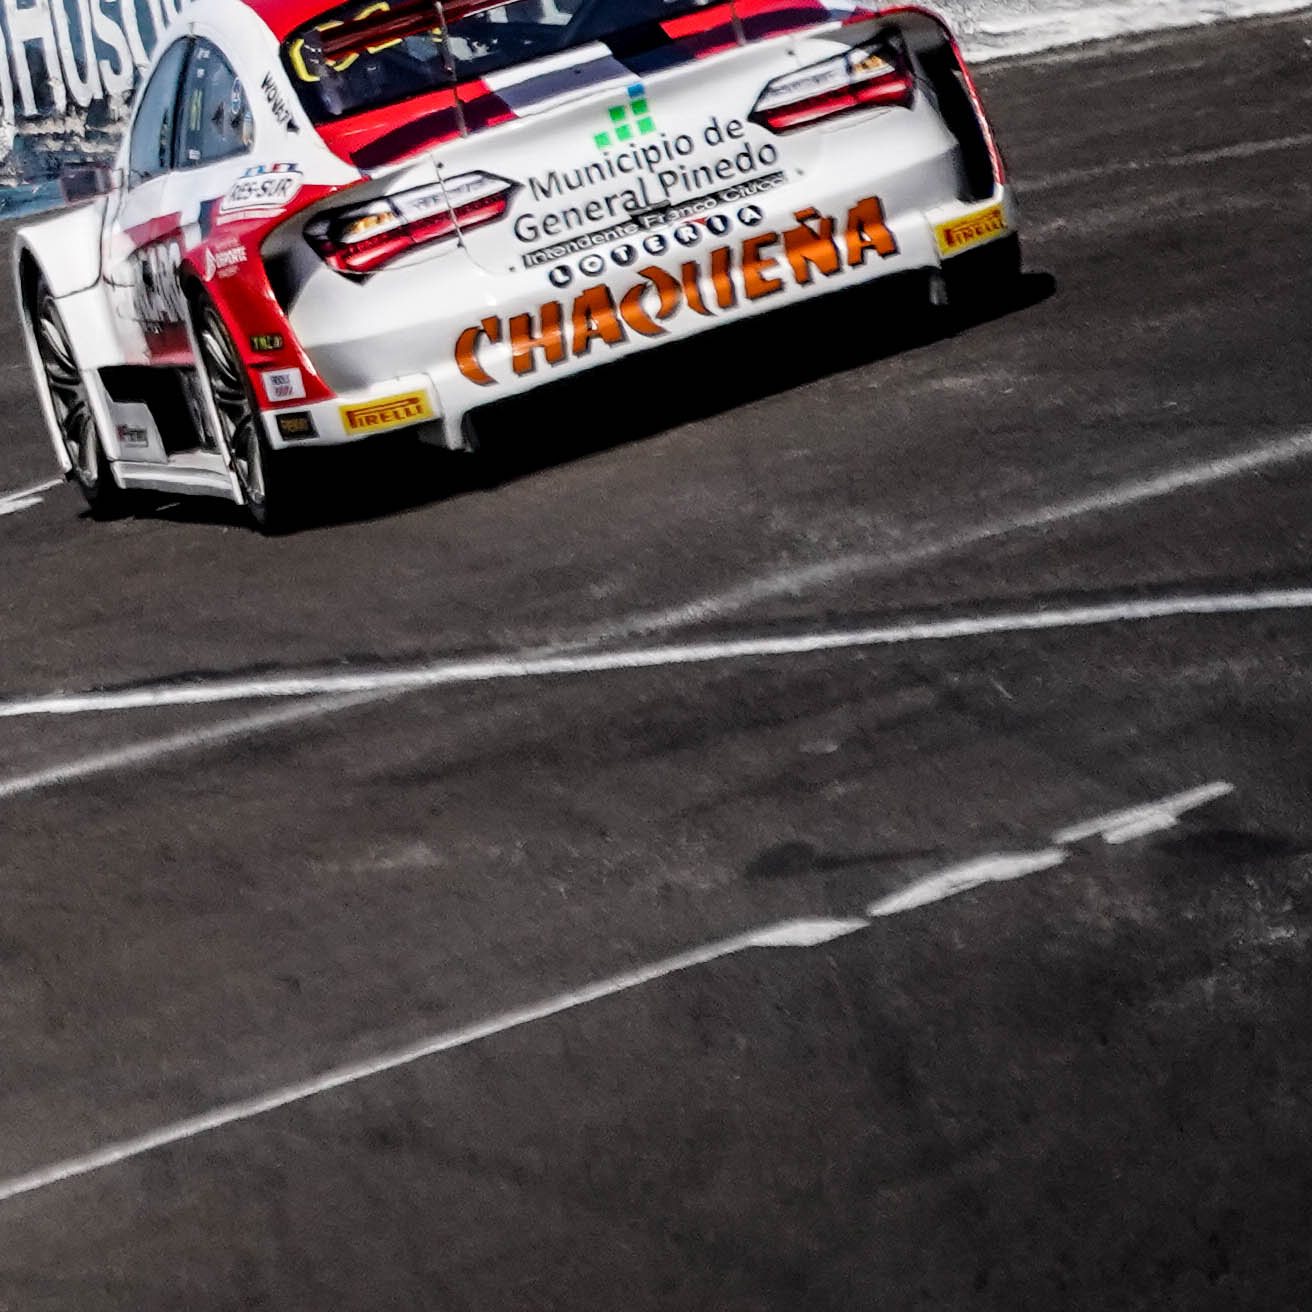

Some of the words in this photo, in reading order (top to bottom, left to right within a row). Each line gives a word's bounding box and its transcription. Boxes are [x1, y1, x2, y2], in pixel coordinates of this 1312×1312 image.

[513, 177, 657, 243] General
[659, 143, 778, 197] Pinedo
[528, 132, 695, 201] Municipio
[704, 116, 746, 146] de
[526, 222, 640, 266] Intendente
[643, 197, 717, 229] Franco
[548, 204, 764, 288] LOTERIA
[454, 195, 900, 385] CHAQUEÑA
[346, 396, 425, 429] PIRELLI
